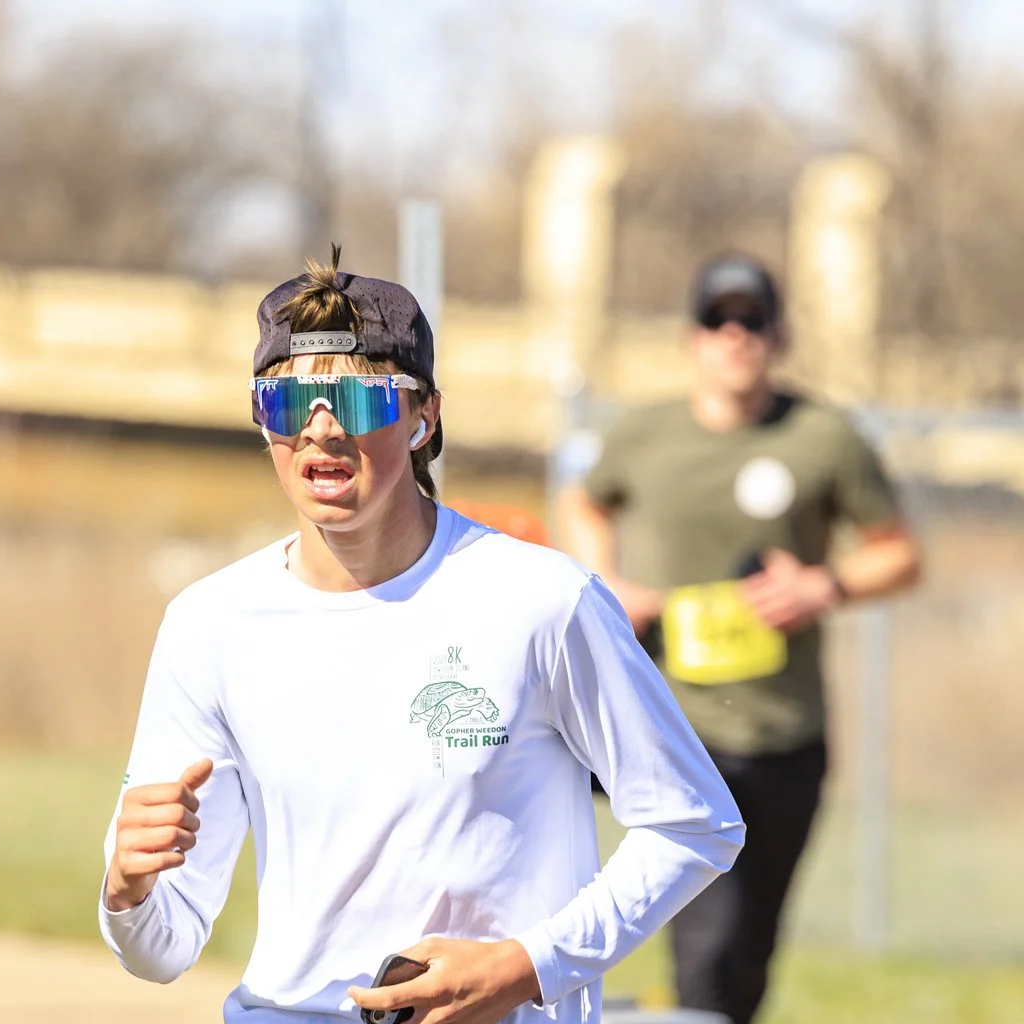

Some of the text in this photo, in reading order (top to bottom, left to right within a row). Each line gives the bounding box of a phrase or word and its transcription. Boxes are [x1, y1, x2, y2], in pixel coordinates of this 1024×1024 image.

[447, 646, 463, 663] 8K
[476, 726, 507, 734] WEEDON
[445, 734, 509, 748] Trail Run
